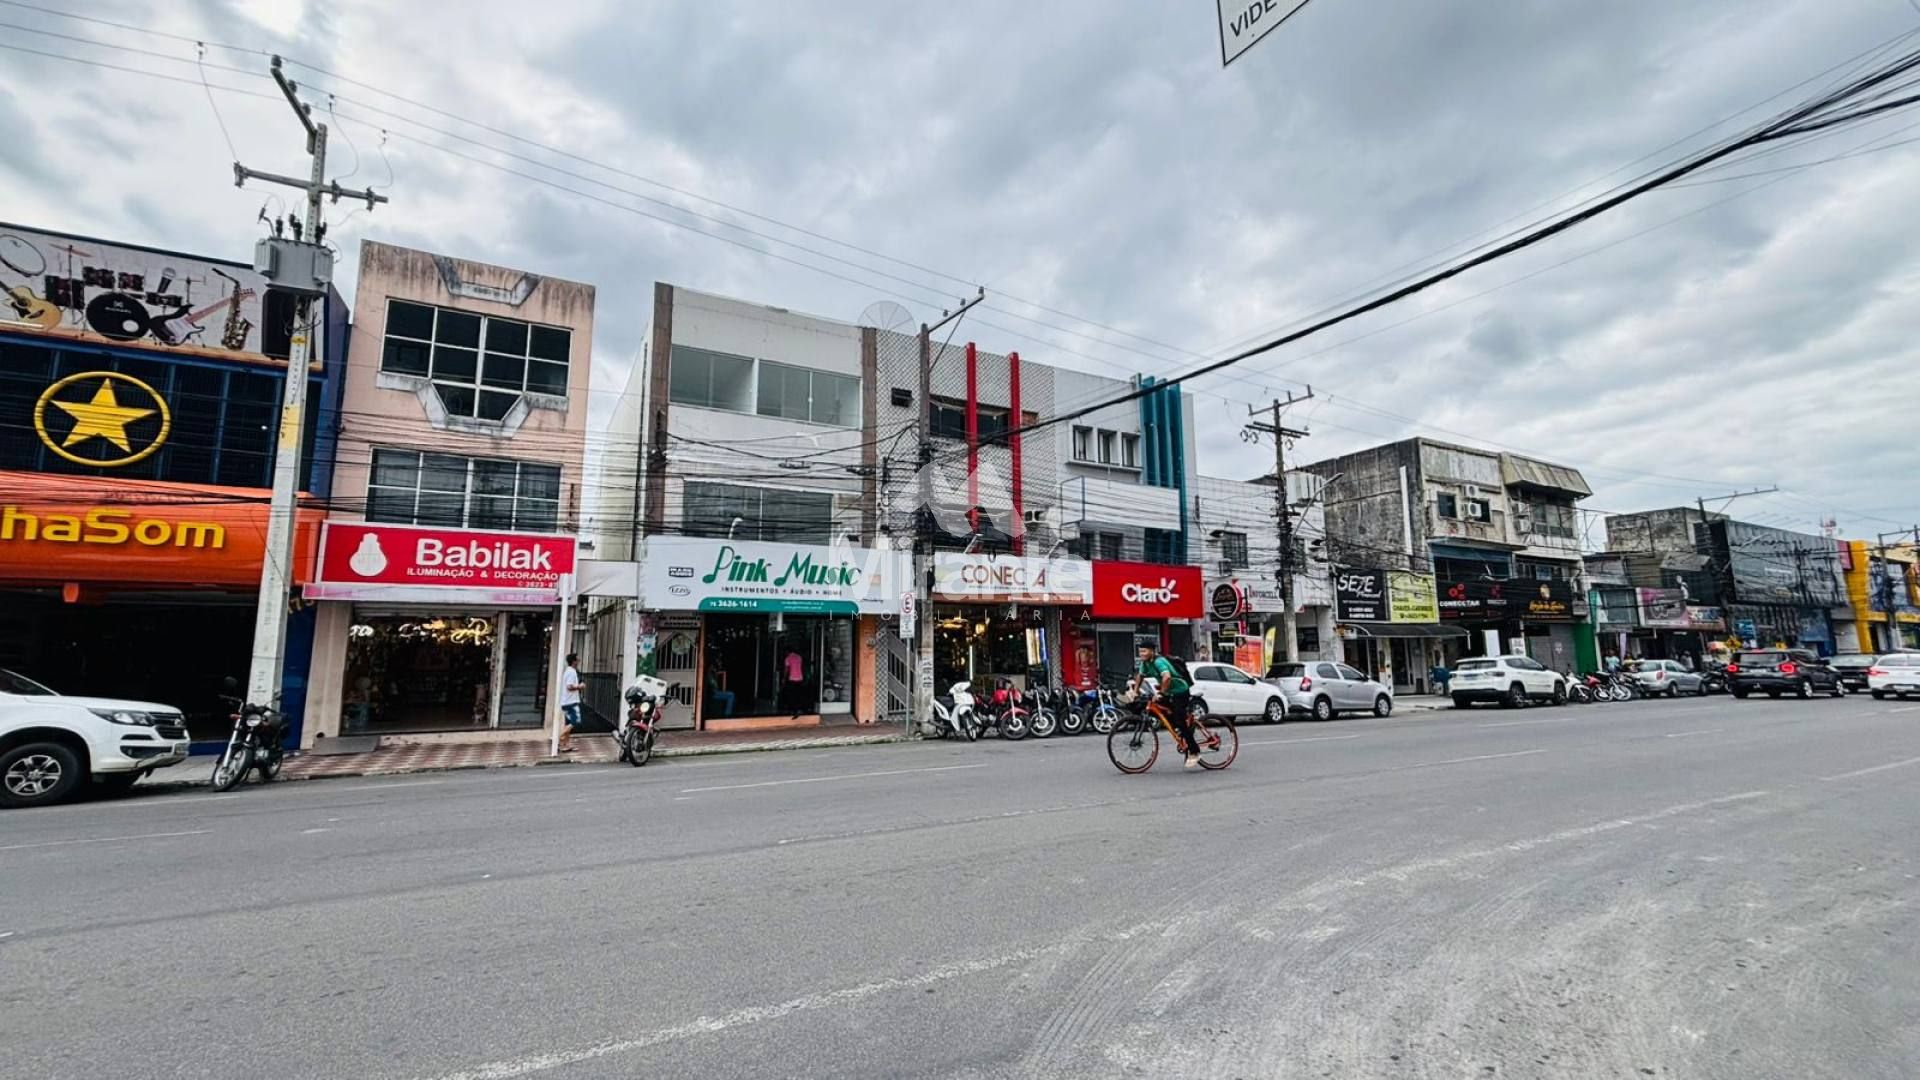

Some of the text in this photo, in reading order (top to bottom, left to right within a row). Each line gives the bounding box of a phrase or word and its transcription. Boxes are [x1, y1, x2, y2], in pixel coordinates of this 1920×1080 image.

[415, 538, 552, 570] Babilak
[702, 546, 862, 587] Pink Music
[406, 567, 559, 582] ILUMINAÇÃO & DECORAÇÃO
[721, 586, 779, 594] INSTRUMENTOS
[1121, 577, 1180, 604] Claro
